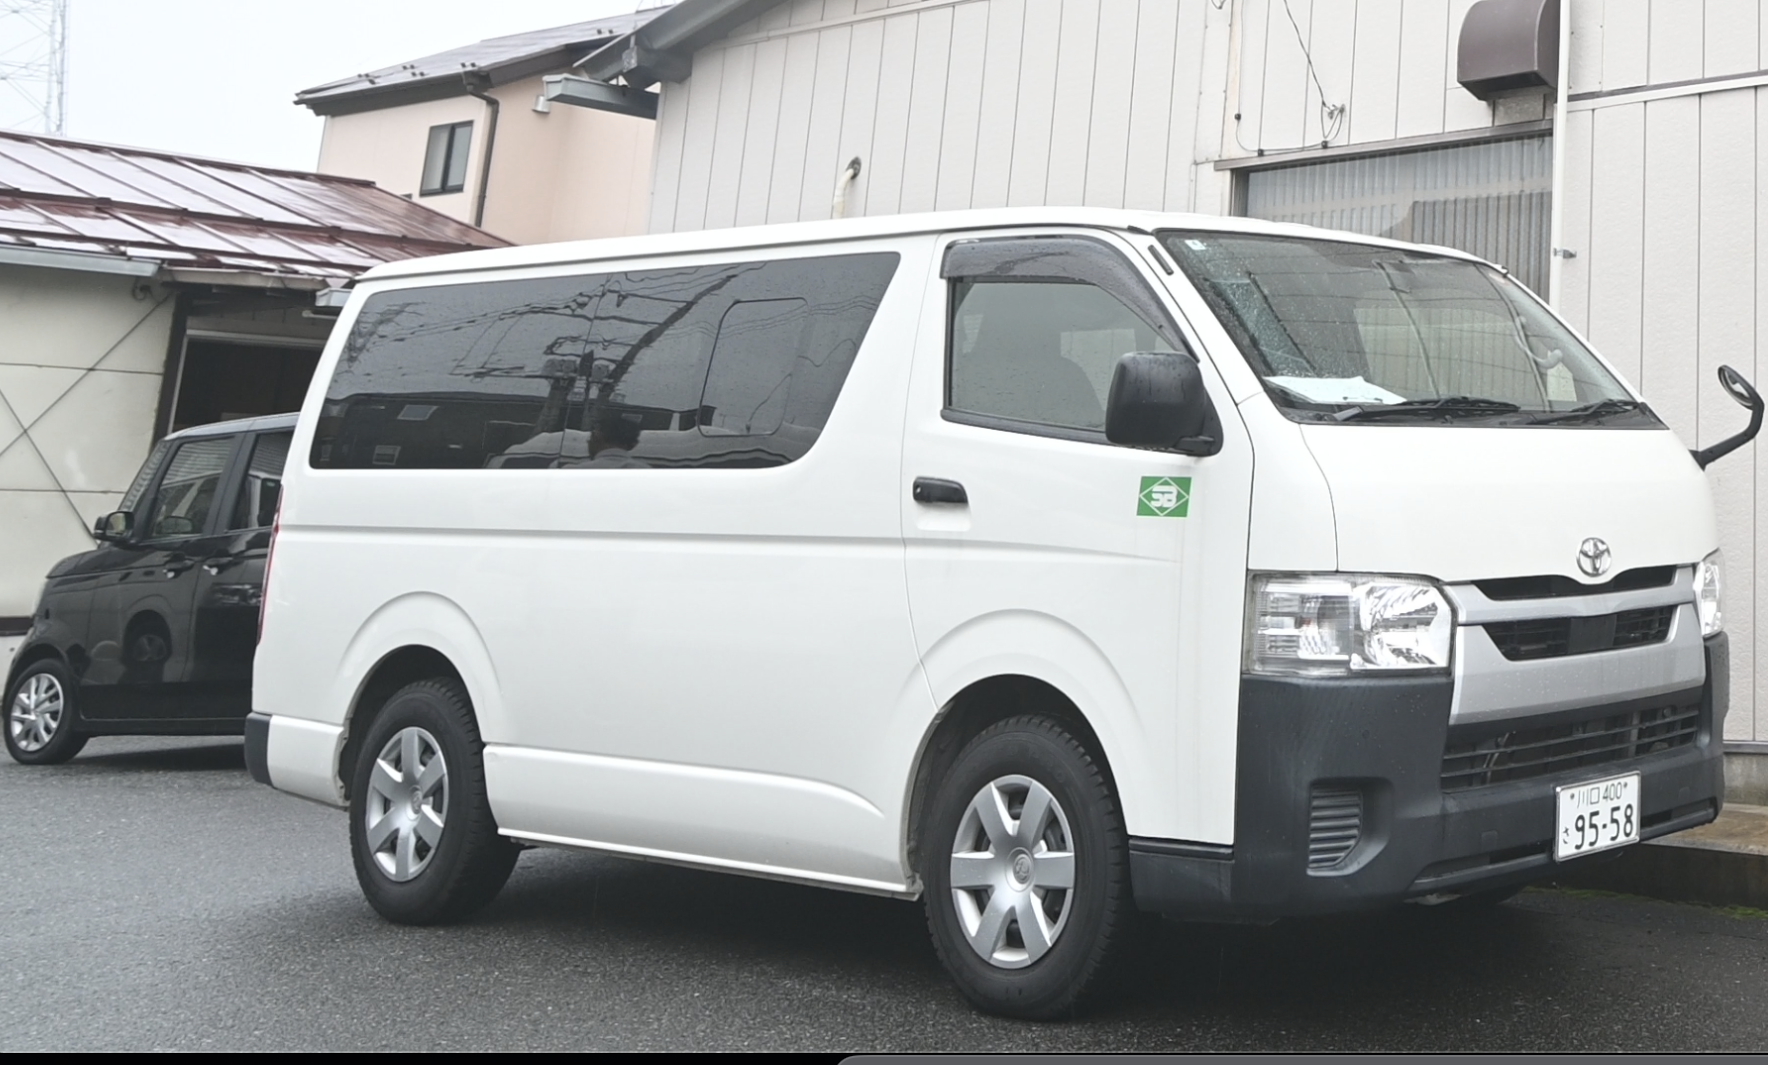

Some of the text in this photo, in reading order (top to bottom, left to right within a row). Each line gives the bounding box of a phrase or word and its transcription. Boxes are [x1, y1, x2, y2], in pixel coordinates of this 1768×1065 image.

[1577, 782, 1622, 809] 川口 400
[1574, 803, 1633, 850] 95-58
